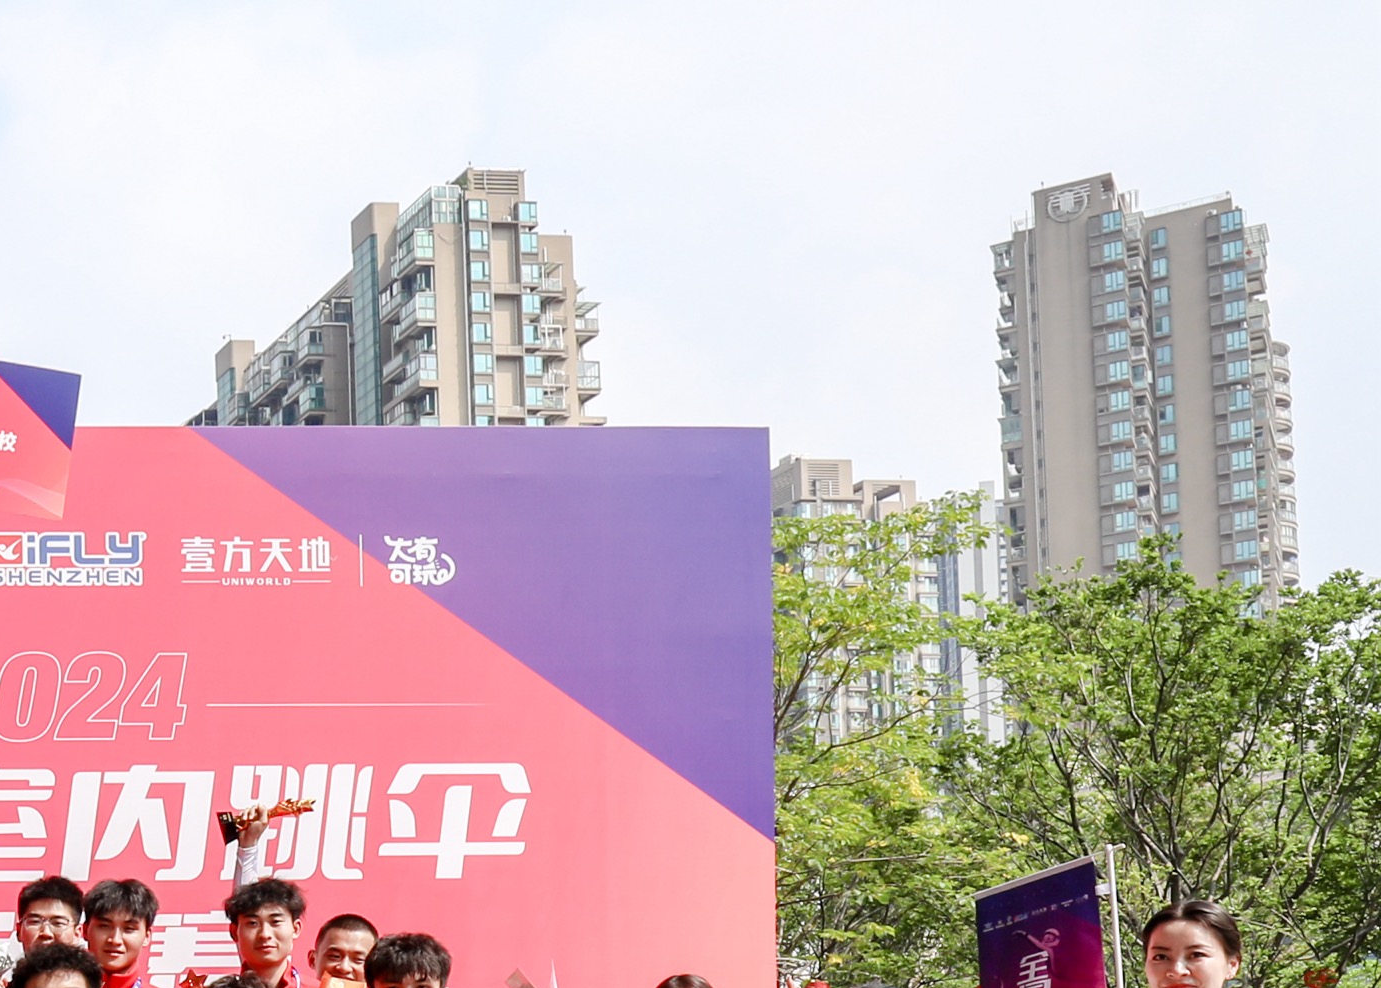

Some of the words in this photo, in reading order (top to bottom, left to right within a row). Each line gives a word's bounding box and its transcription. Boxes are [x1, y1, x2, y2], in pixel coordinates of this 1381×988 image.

[26, 534, 143, 566] iFLY
[181, 536, 331, 574] 壹方天地
[383, 535, 439, 562] 大有
[222, 577, 292, 586] UNIWORLD
[387, 562, 452, 585] 可玩
